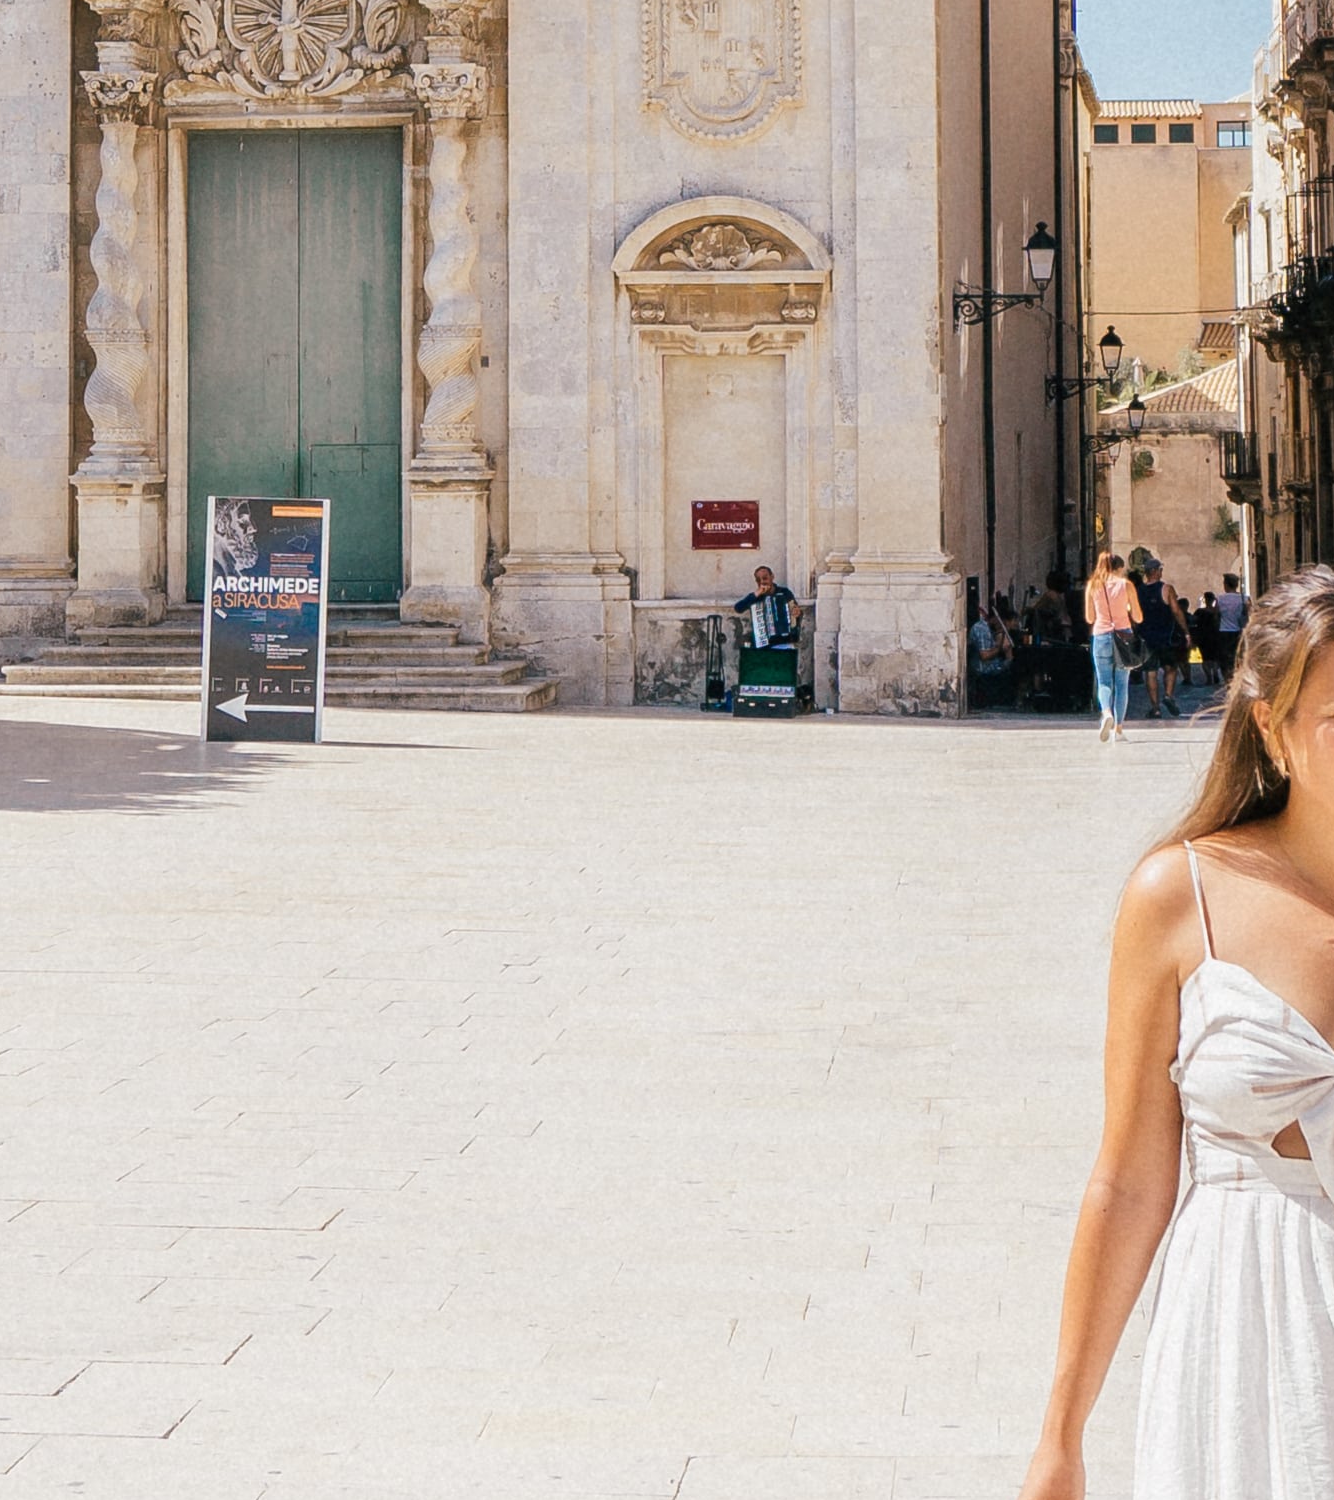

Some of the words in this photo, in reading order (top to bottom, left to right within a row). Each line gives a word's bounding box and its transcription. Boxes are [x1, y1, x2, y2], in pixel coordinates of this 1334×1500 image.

[696, 518, 755, 534] Caravaggio
[212, 576, 319, 594] ARCHIMEDE
[212, 595, 222, 608] a
[224, 592, 301, 609] SIRACUSA
